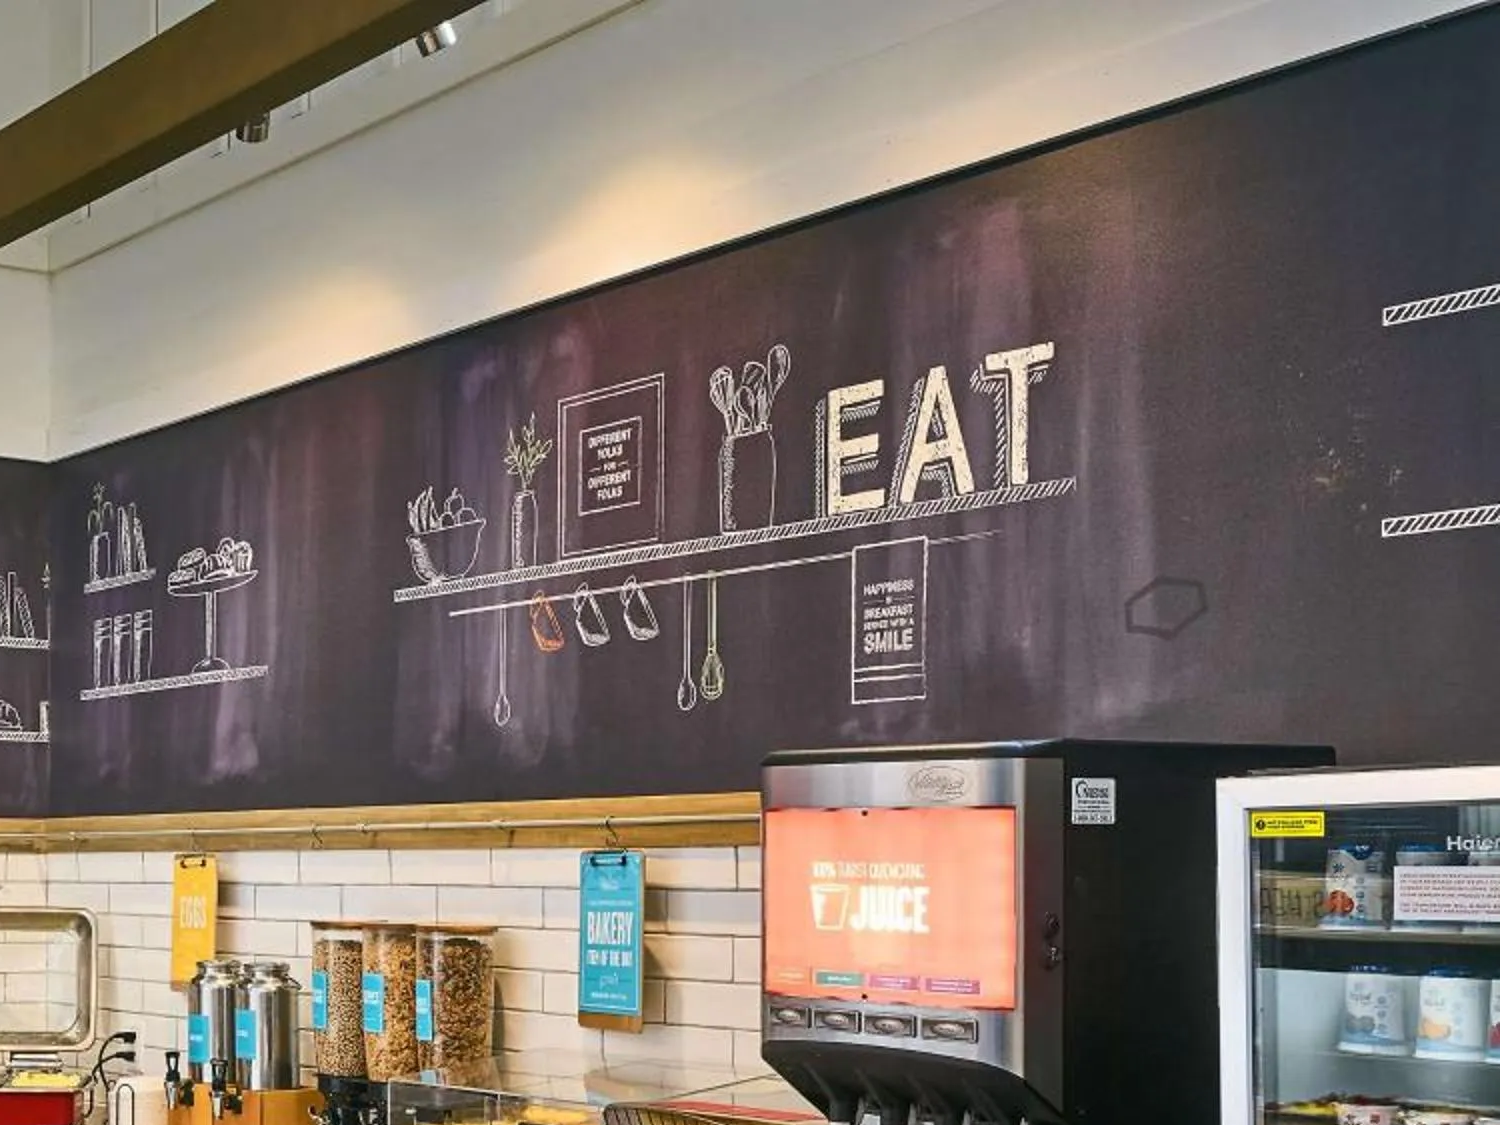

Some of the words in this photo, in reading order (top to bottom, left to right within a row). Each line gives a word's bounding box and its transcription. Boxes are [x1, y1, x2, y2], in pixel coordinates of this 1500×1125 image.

[815, 341, 1055, 516] EAT
[587, 469, 632, 490] DIFFERENT
[863, 579, 915, 596] HAPPINESS
[863, 604, 913, 620] BREAKFAST
[863, 629, 914, 655] SMILE
[849, 885, 932, 935] JUICE
[587, 911, 634, 946] BAKERY
